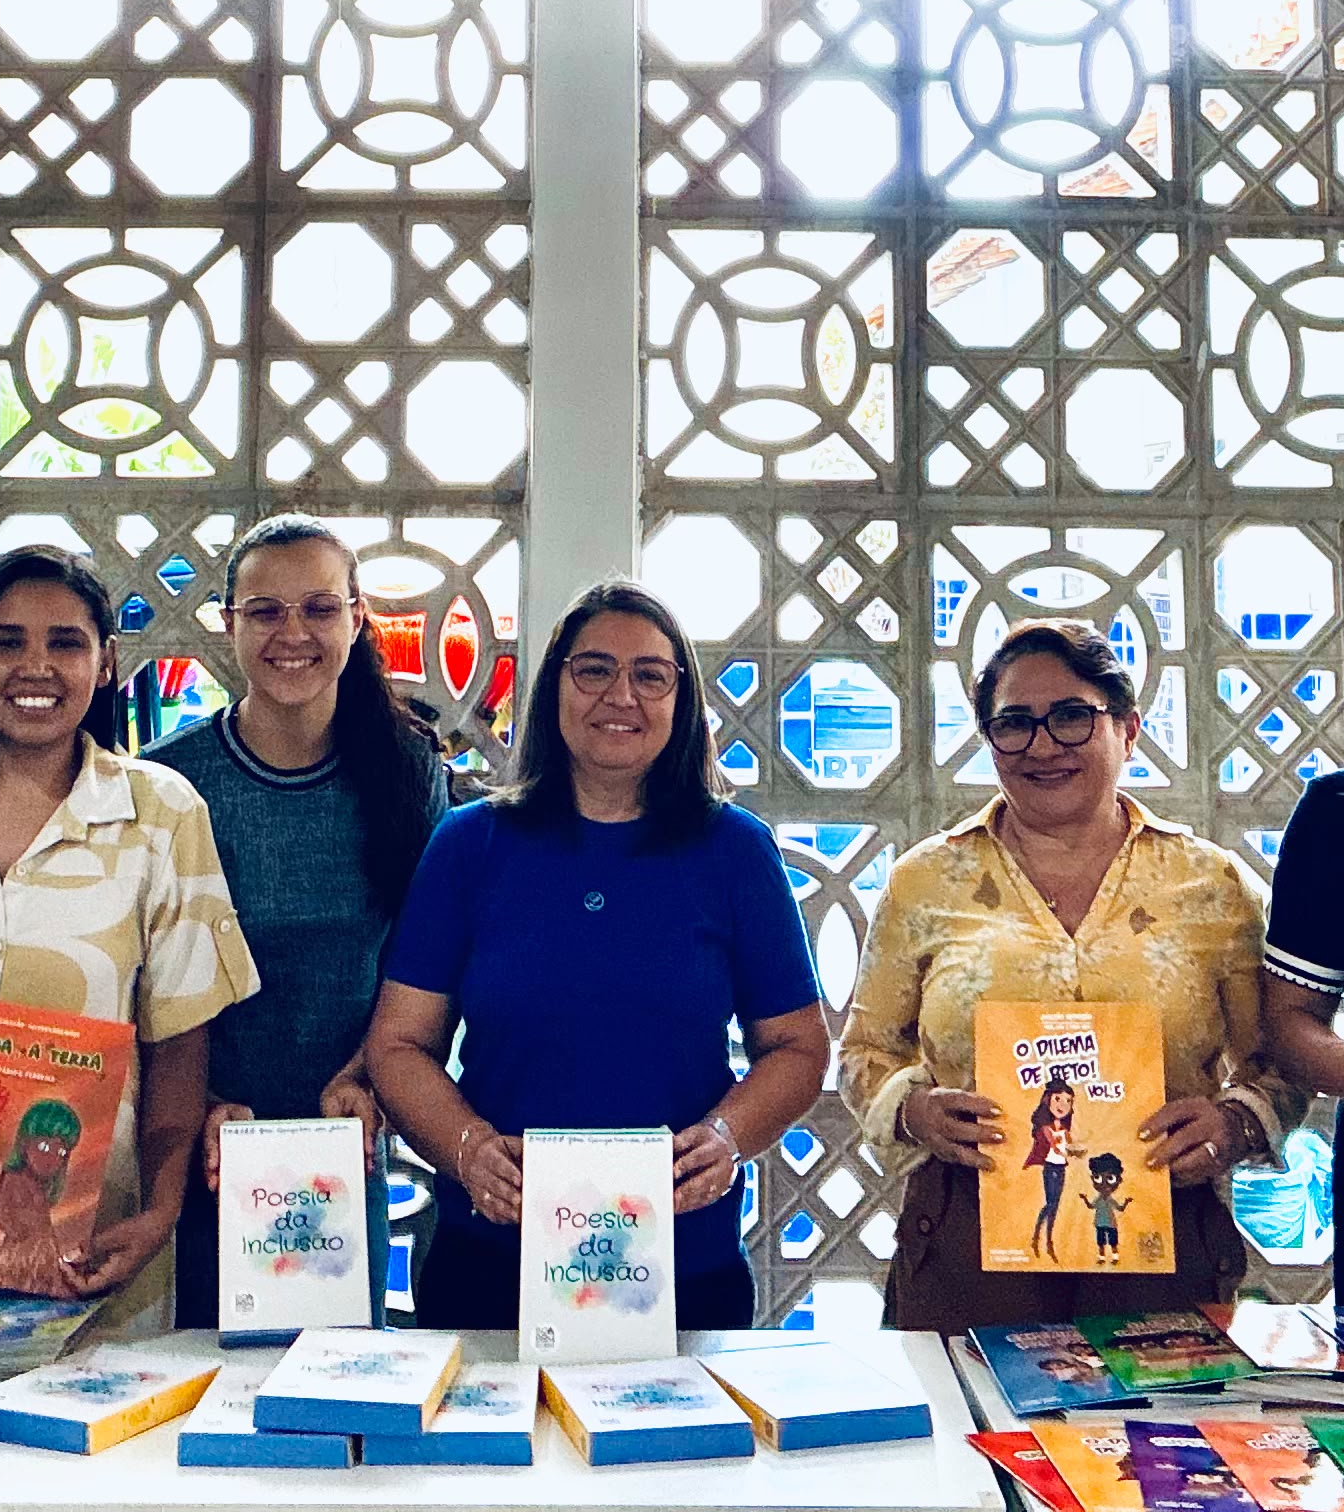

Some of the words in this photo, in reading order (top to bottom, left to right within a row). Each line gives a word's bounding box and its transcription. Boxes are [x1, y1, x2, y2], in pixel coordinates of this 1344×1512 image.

[1016, 1043, 1029, 1057] O
[1035, 1034, 1096, 1058] DILEMA
[50, 1048, 102, 1071] TERRA
[1020, 1066, 1043, 1085] DE
[251, 1187, 333, 1208] Poesia
[274, 1209, 309, 1231] da
[555, 1206, 639, 1230] Poesia
[578, 1233, 614, 1257] da
[544, 1260, 650, 1283] Inclusão
